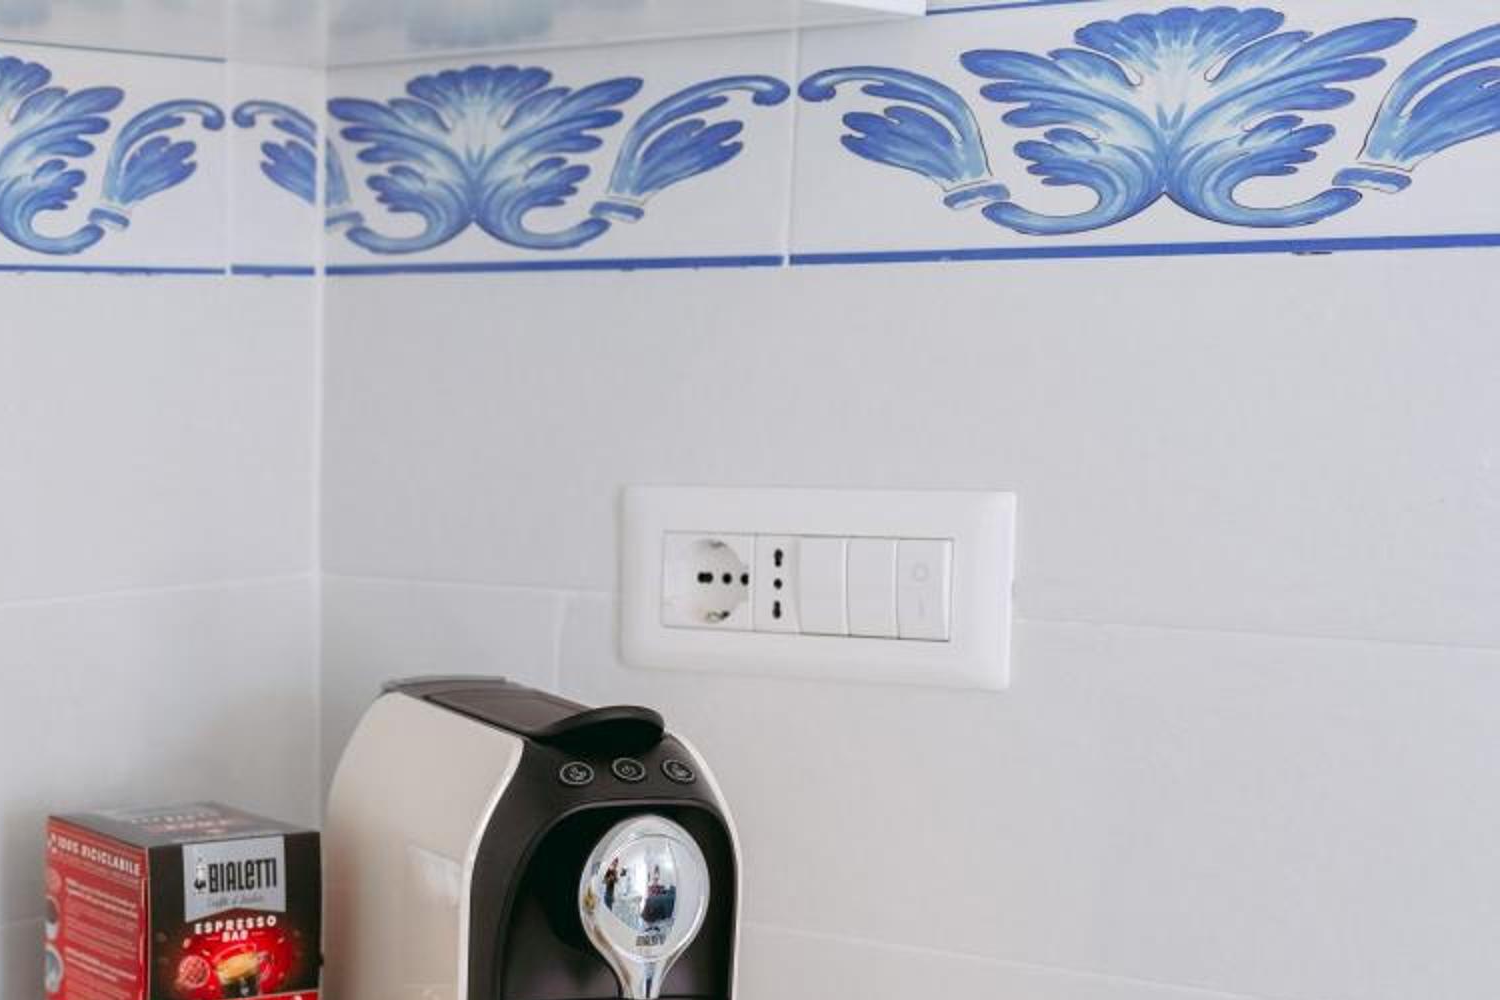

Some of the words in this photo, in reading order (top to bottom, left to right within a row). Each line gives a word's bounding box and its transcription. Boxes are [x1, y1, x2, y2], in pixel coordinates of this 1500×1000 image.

[208, 858, 278, 893] BIALETTI
[194, 915, 277, 935] ESPRESSO
[222, 930, 248, 943] BAR
